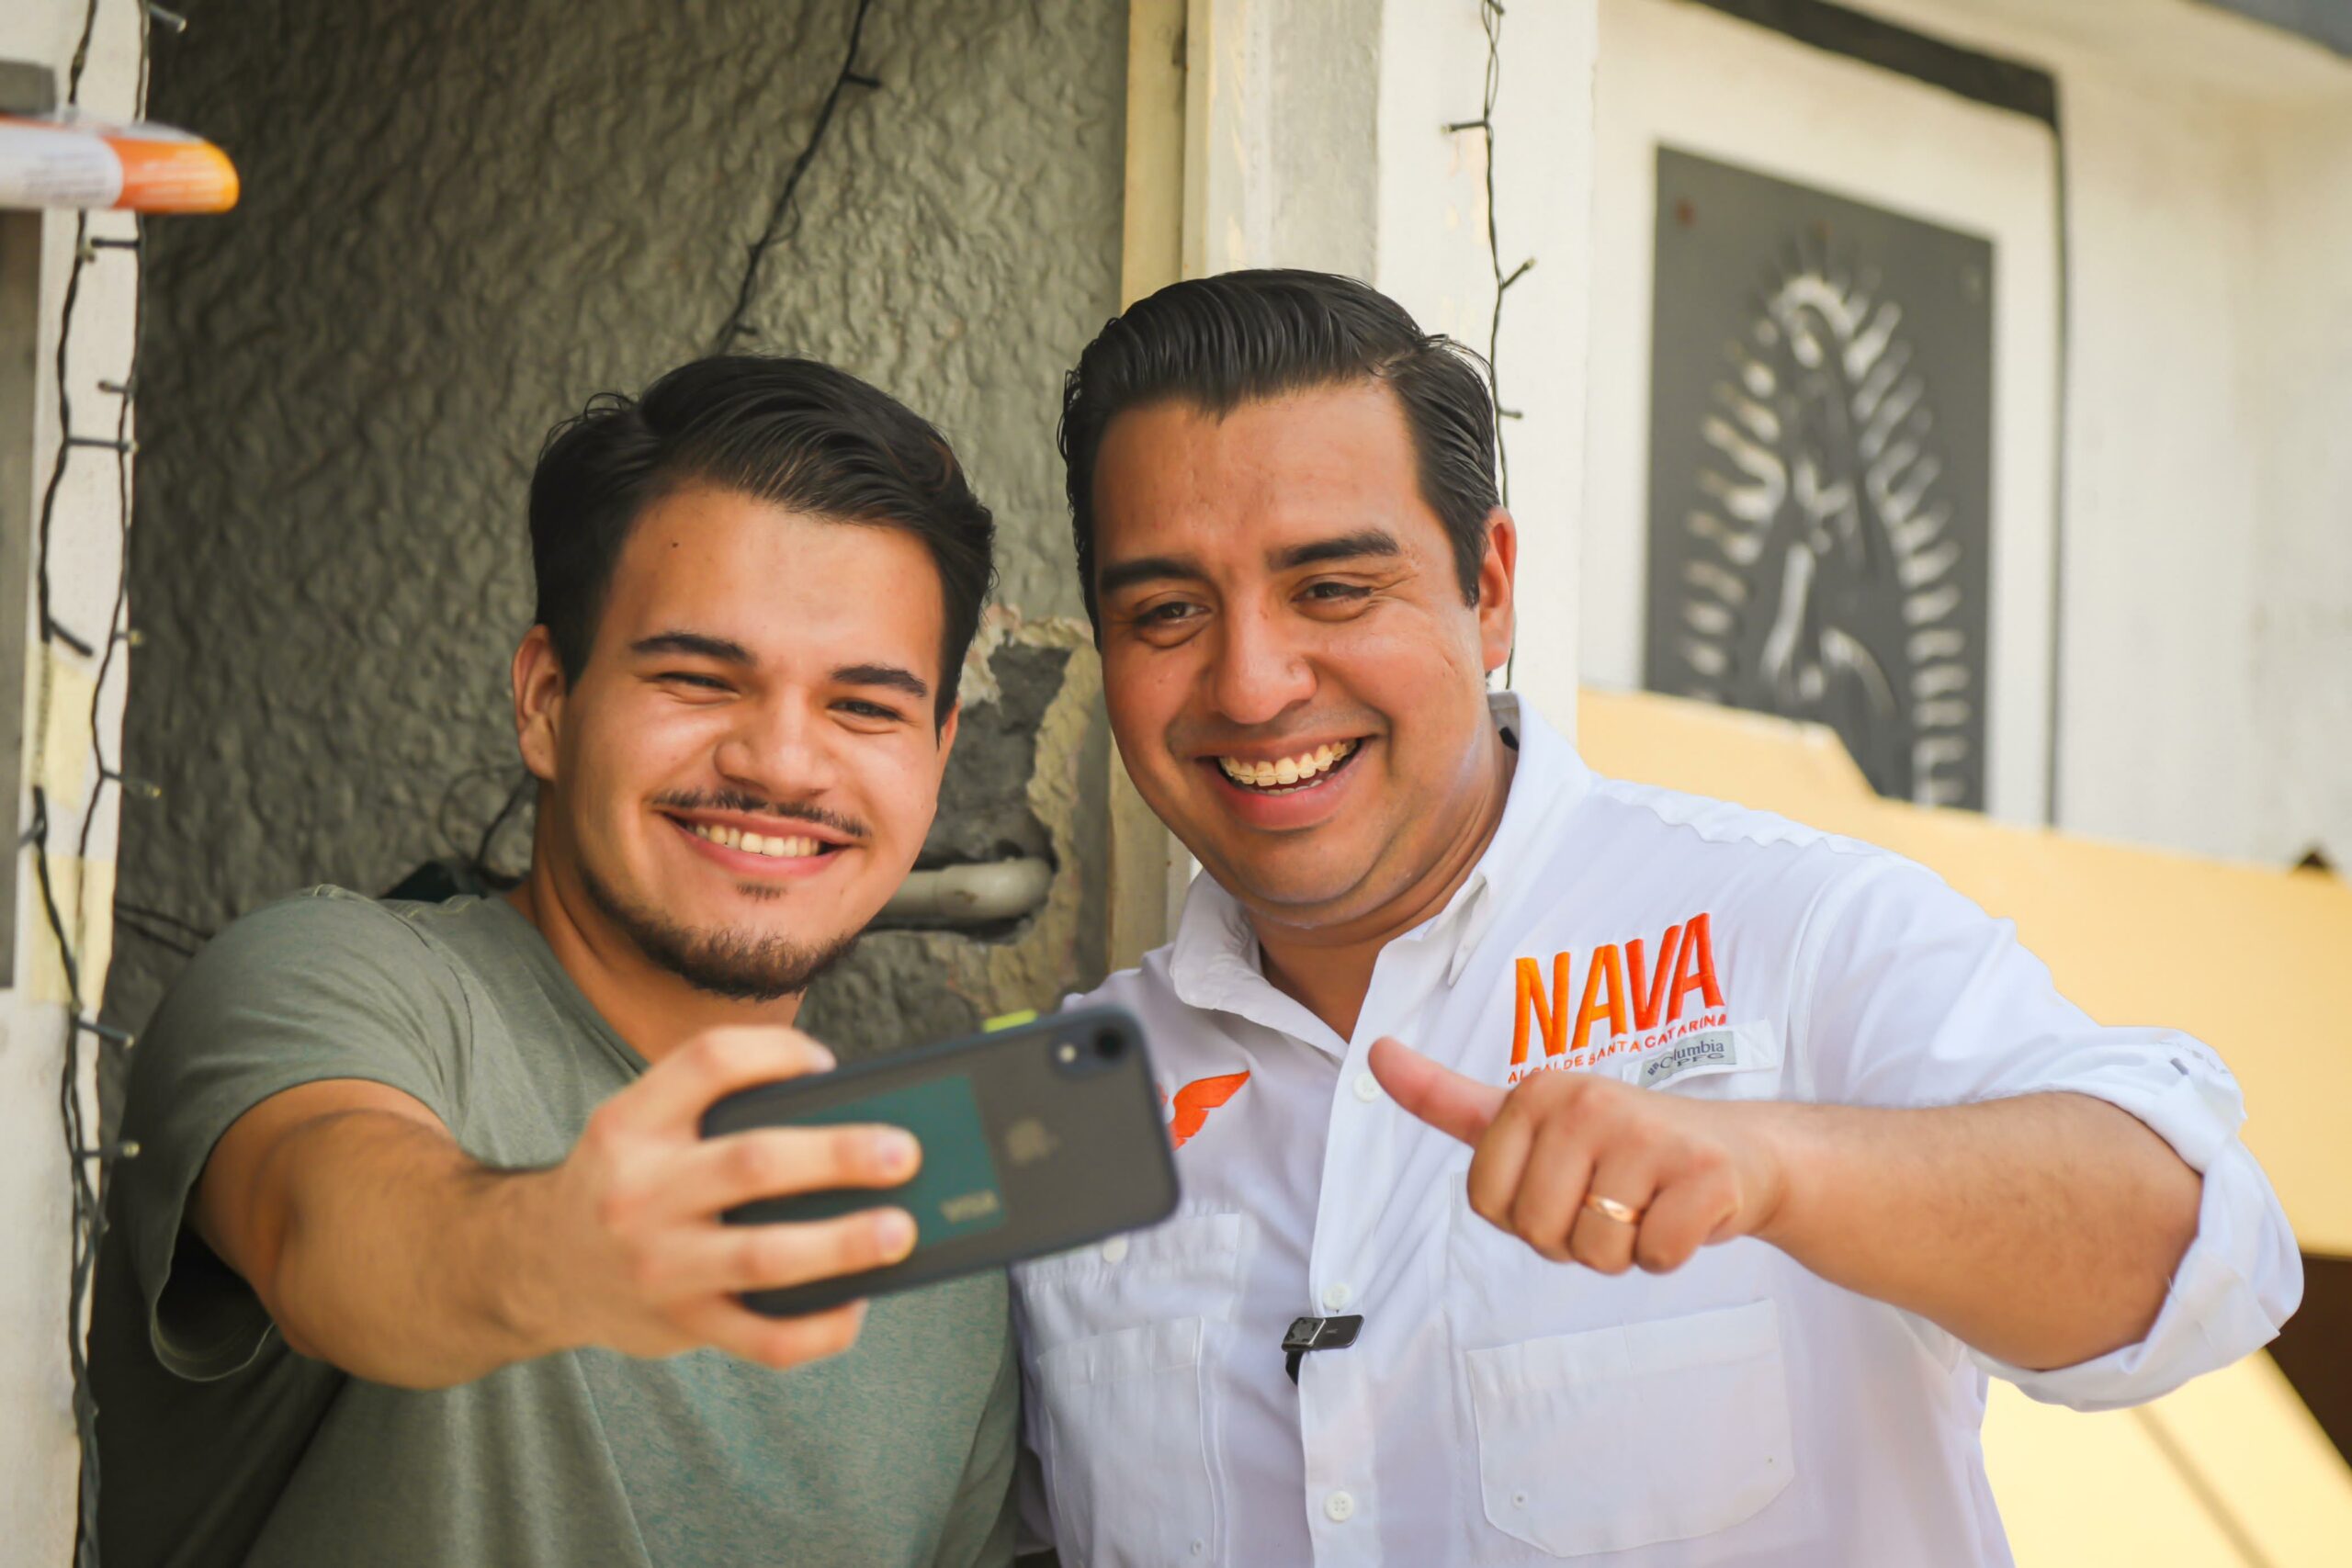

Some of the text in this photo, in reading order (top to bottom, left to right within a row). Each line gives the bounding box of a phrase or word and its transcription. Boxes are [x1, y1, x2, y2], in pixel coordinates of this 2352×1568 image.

[1510, 912, 1725, 1066] NAVA
[1588, 1040, 1642, 1066] SANTA
[1645, 1013, 1727, 1048] CATARINA
[1659, 1039, 1724, 1069] Clumbia
[1677, 1053, 1724, 1067] PFG
